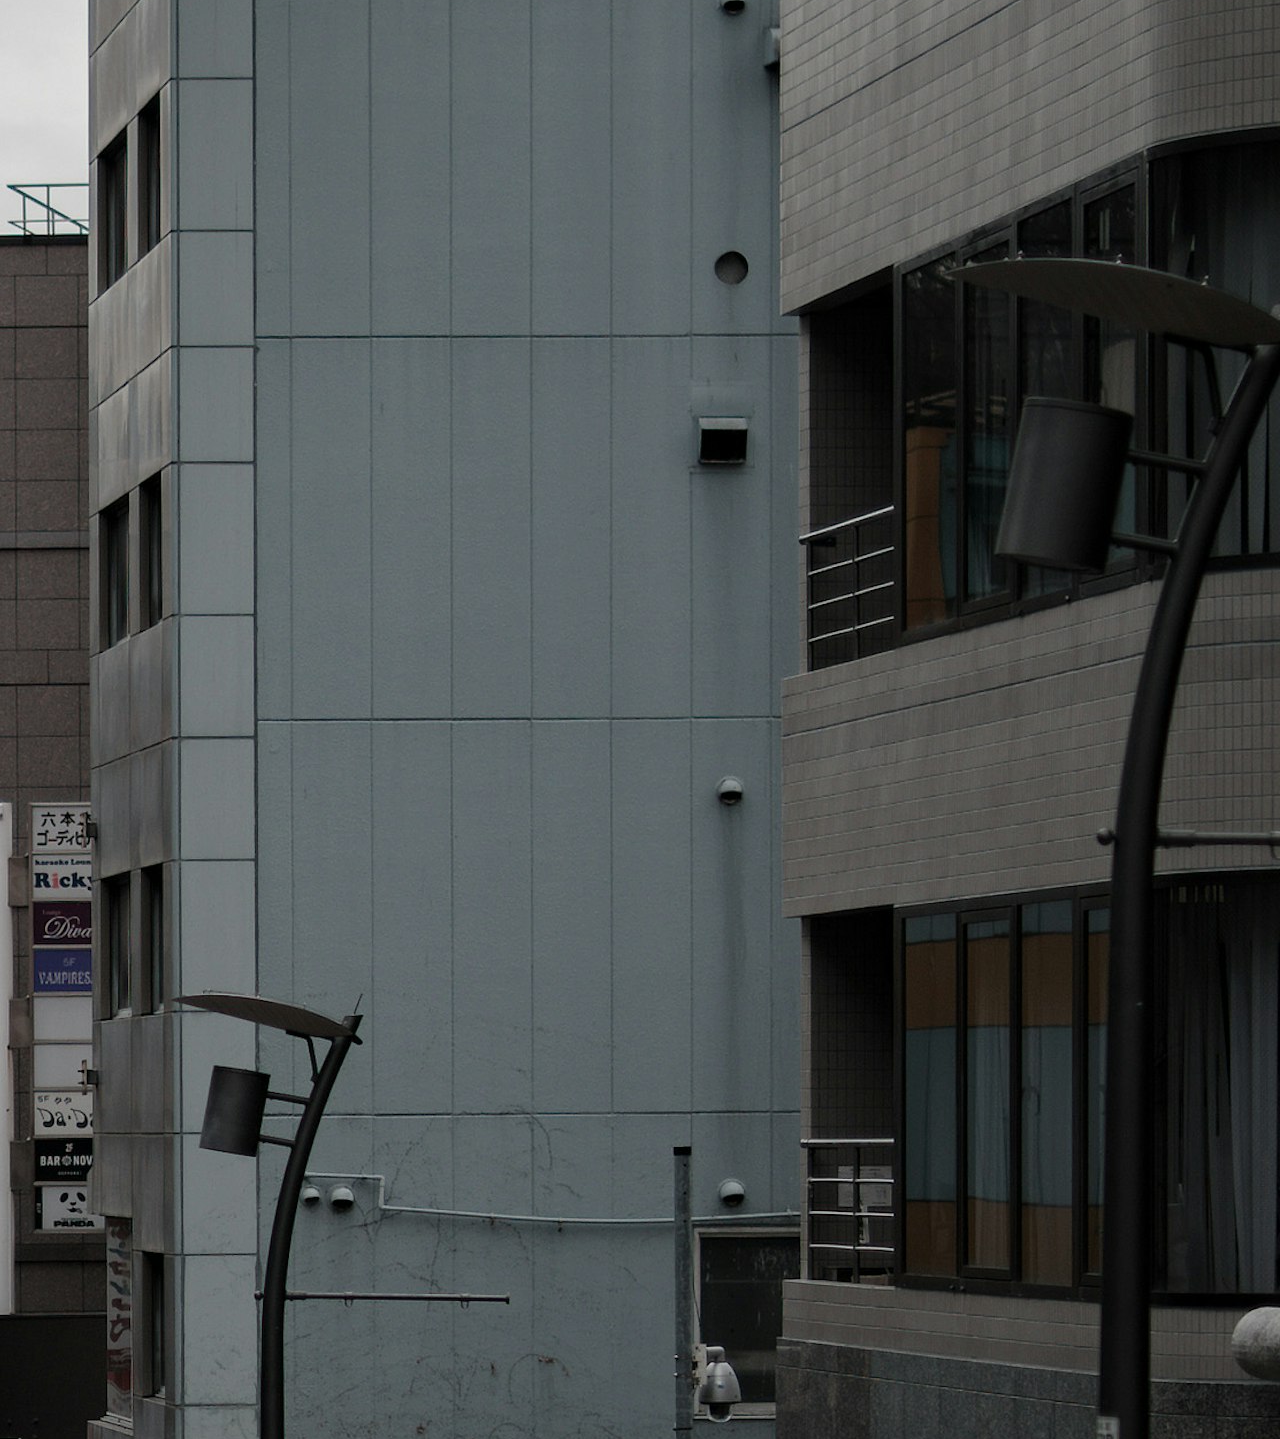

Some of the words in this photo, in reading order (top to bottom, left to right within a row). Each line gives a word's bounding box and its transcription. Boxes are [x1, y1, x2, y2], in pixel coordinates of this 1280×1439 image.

[43, 915, 93, 940] Diva
[40, 1155, 60, 1167] BAR
[73, 1155, 93, 1167] NOV
